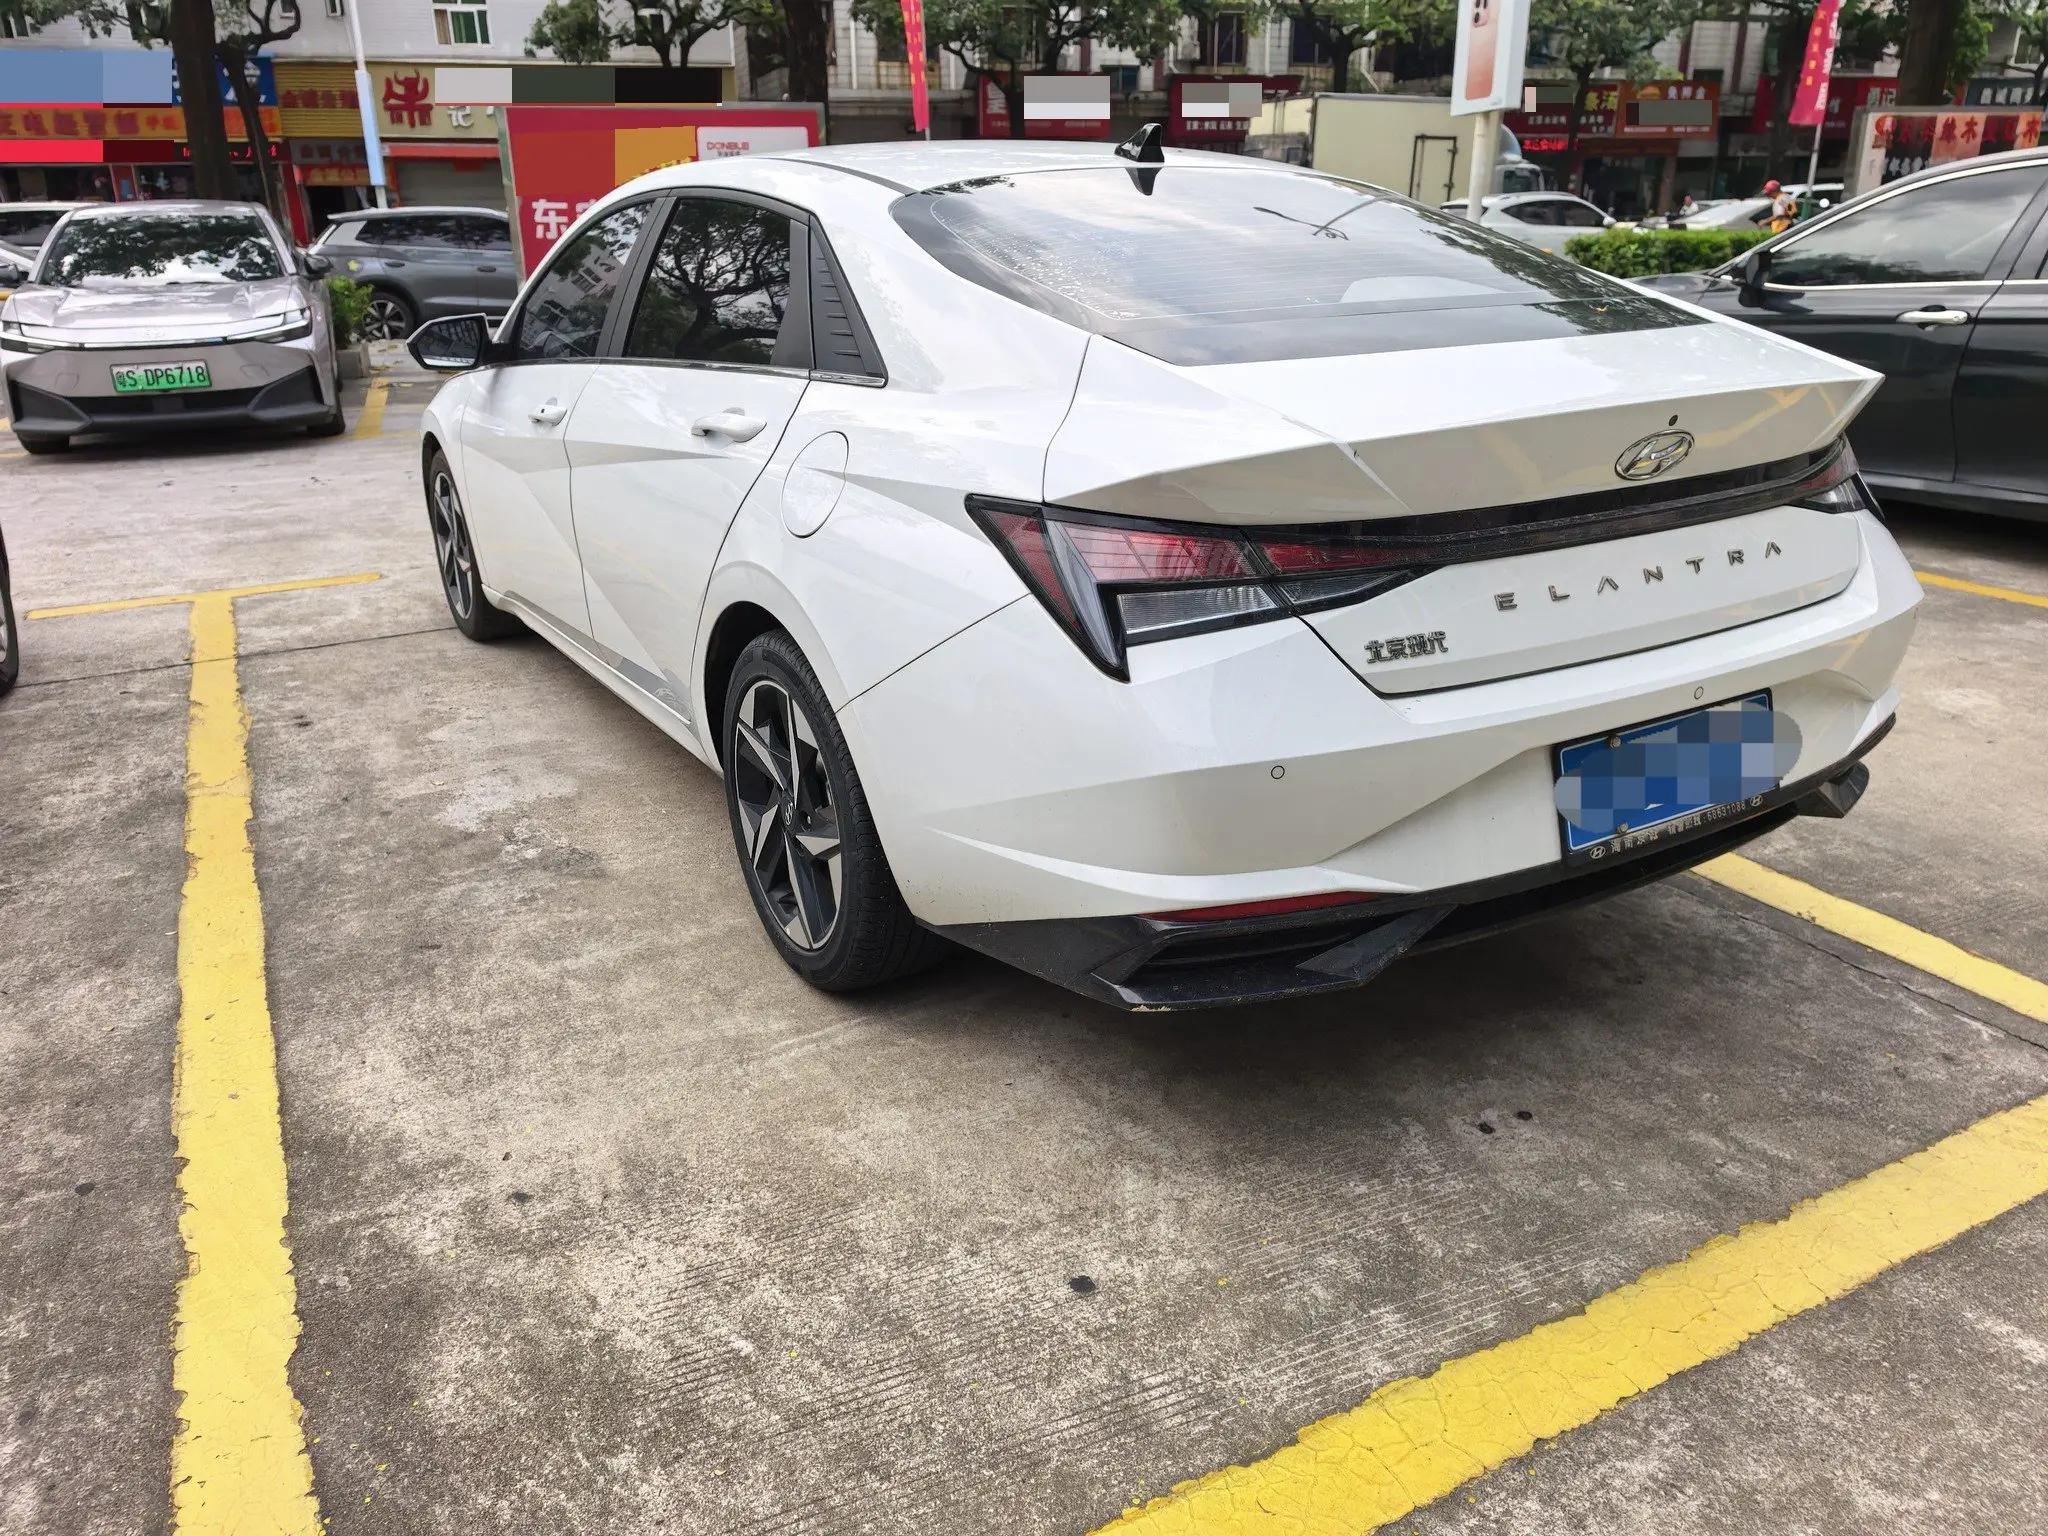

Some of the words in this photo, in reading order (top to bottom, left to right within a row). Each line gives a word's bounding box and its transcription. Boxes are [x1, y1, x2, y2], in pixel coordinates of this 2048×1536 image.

[1494, 541, 1782, 611] ELANTRA
[1363, 630, 1449, 664] 北京现代
